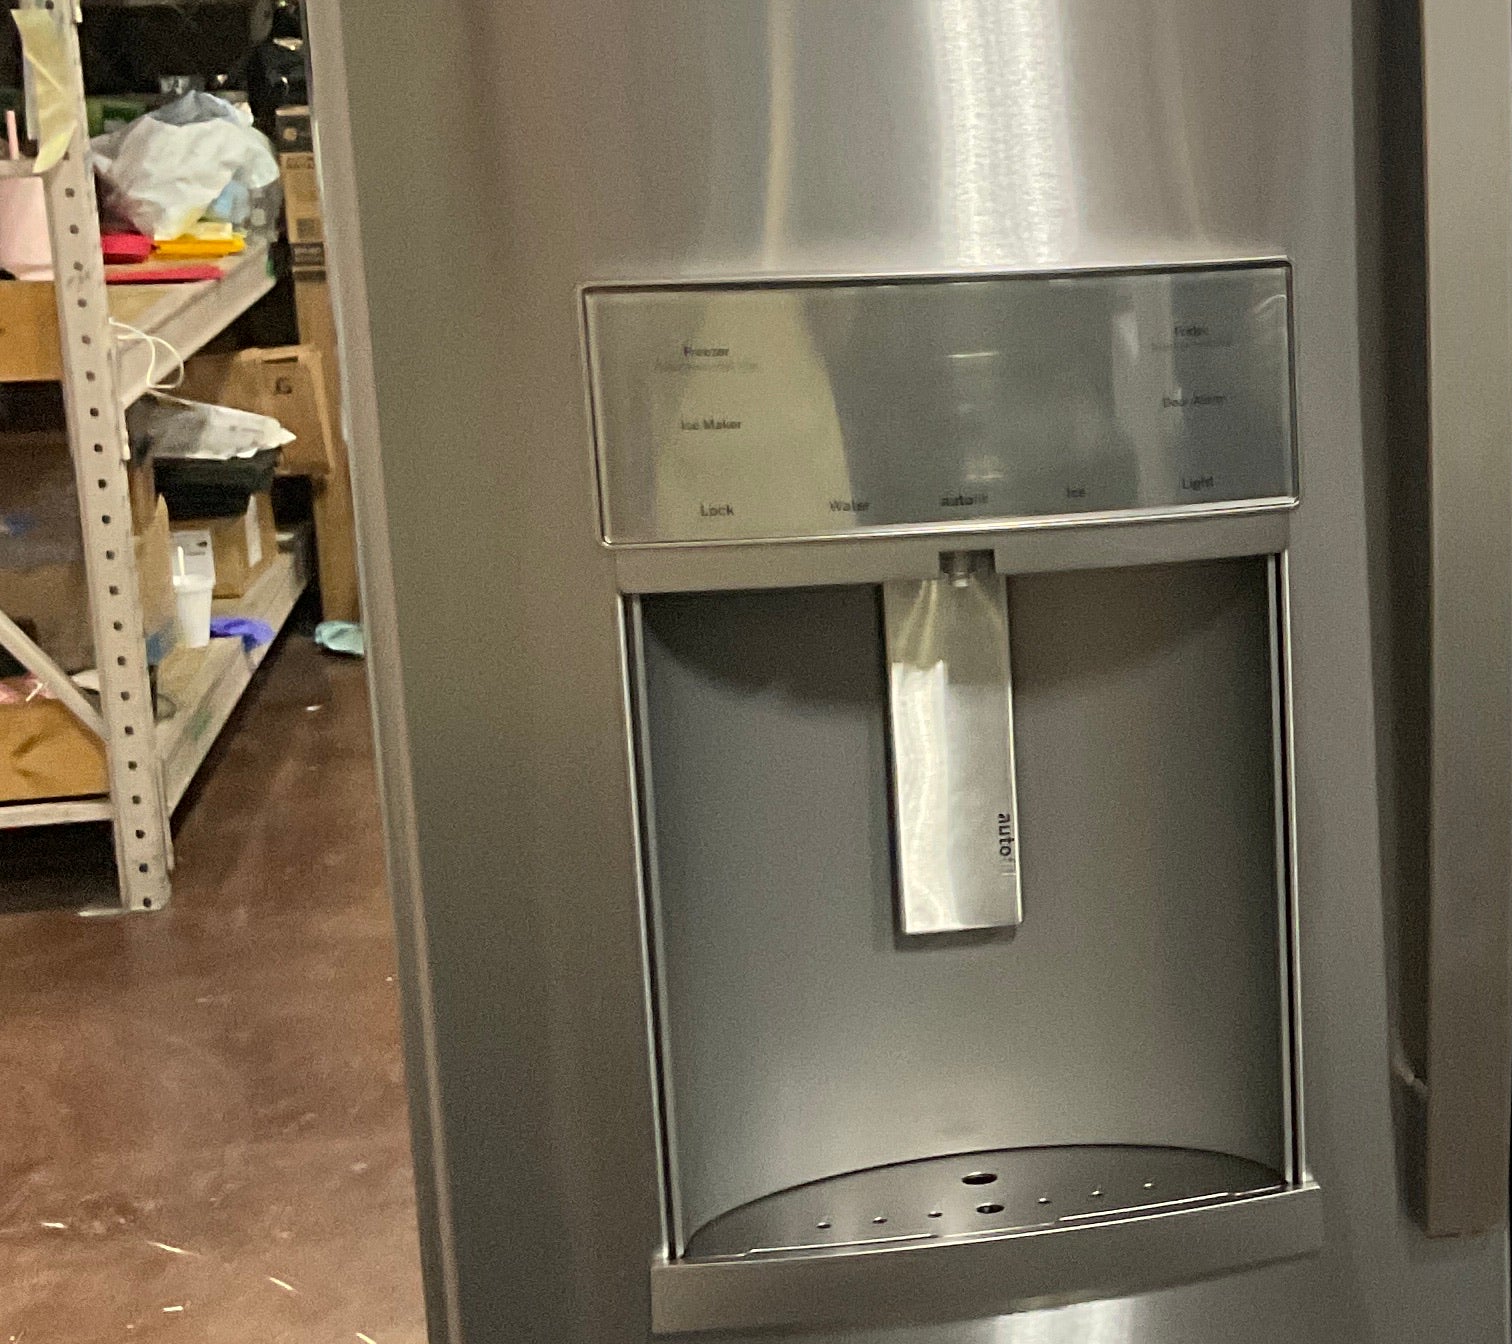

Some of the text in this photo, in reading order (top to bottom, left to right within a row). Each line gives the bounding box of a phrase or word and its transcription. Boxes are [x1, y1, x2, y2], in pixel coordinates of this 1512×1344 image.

[683, 345, 730, 358] Freezer
[703, 418, 742, 431] Maker
[1182, 475, 1215, 491] Light
[1066, 487, 1087, 499] Ice
[700, 502, 735, 517] Lock
[829, 500, 871, 513] Water
